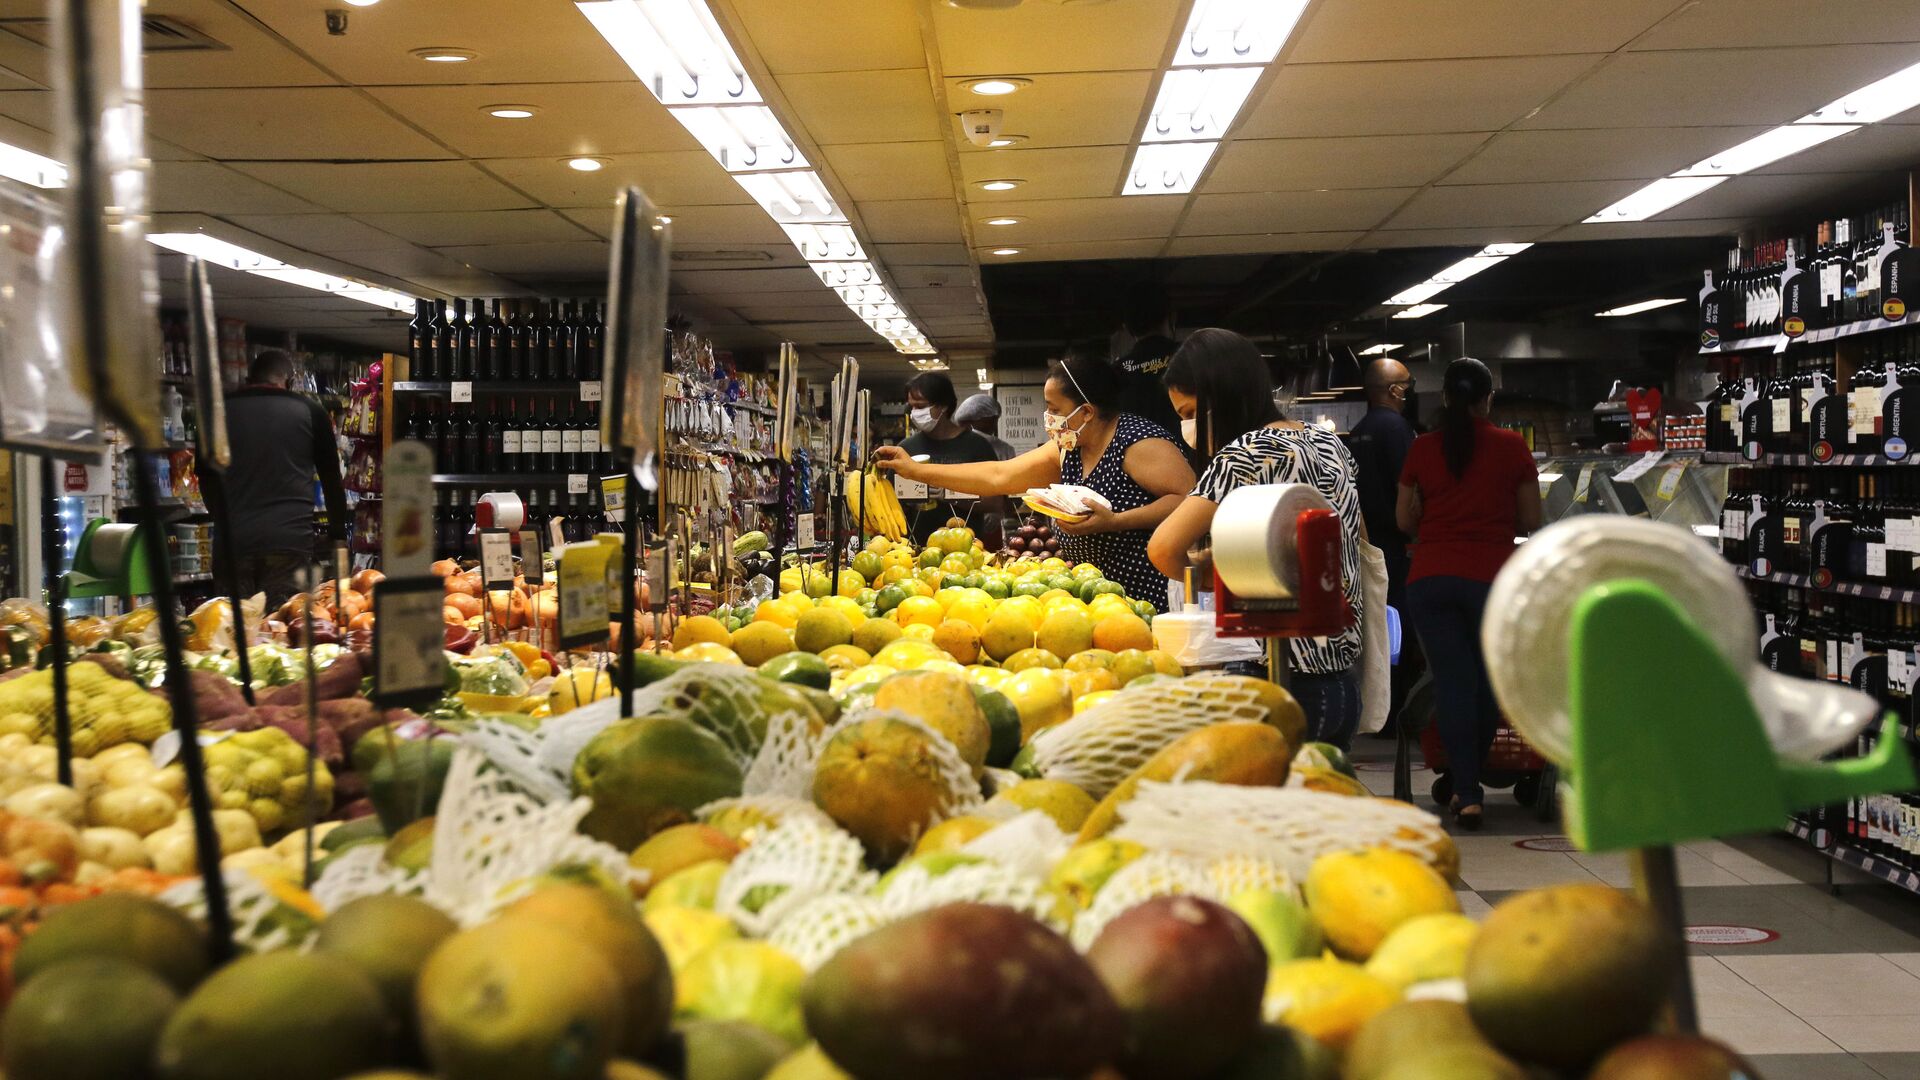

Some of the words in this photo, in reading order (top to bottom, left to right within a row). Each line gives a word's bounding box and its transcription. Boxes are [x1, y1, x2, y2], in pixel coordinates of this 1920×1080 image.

[1891, 261, 1899, 293] ESPANHA
[1791, 284, 1800, 313] ESPANHA
[1005, 396, 1018, 405] LEVE
[1020, 396, 1032, 405] UMA
[1005, 407, 1021, 416] PIZZA
[1005, 417, 1038, 428] QUENTINHA
[1819, 405, 1827, 439] PORTUGAL
[1892, 397, 1900, 436] ARGENTINA
[1005, 429, 1020, 439] PARA
[1021, 429, 1035, 439] CASA
[1758, 528, 1766, 552] FRANÇA
[1819, 534, 1828, 566] PORTUGAL
